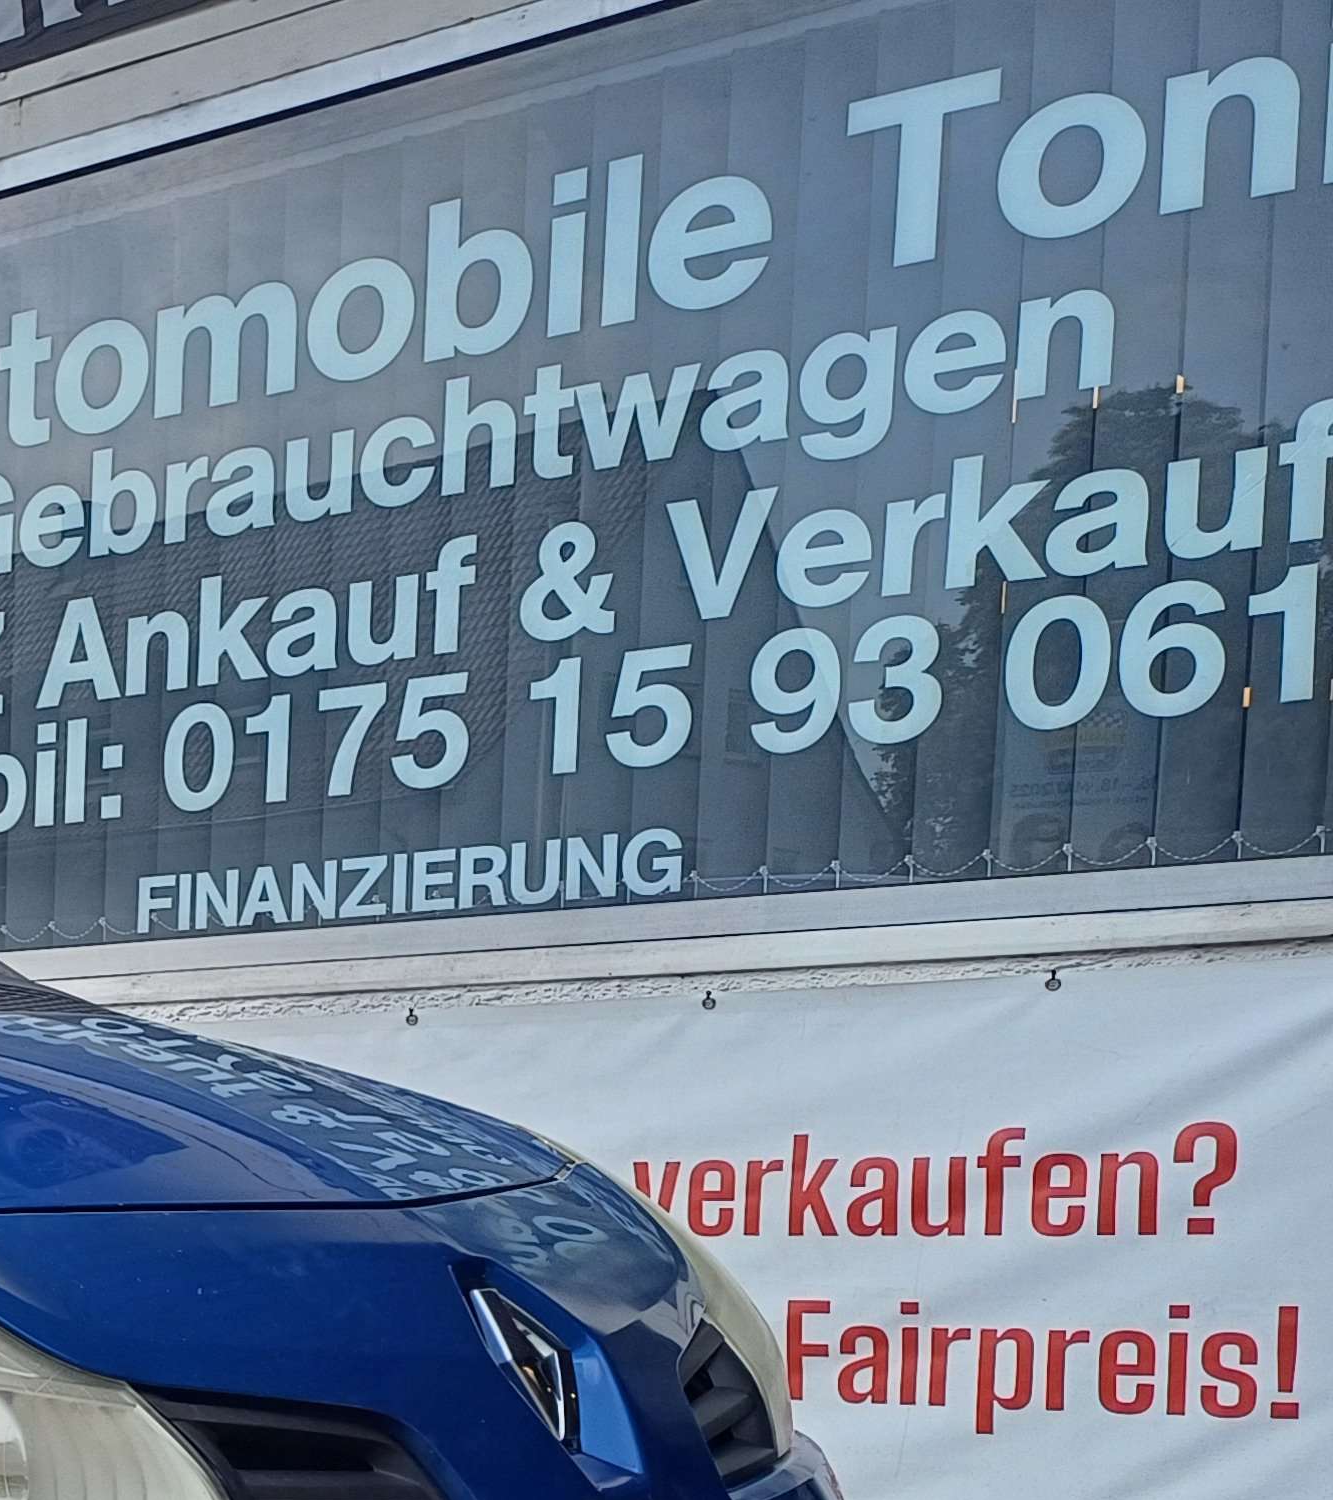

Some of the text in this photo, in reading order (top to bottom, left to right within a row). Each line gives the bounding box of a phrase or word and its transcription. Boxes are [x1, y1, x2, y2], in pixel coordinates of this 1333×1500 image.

[847, 43, 1333, 268] Ton
[36, 535, 478, 708] Ankauf
[519, 521, 616, 641] &
[666, 397, 1333, 620] Verkauf
[163, 672, 470, 811] 0175
[528, 644, 693, 774] 15
[750, 615, 943, 754] 93
[1005, 562, 1319, 731] 061
[137, 828, 684, 934] FINANZIERUNG
[634, 1122, 1238, 1237] verkaufen?
[786, 1300, 1300, 1435] Fairpreis!
